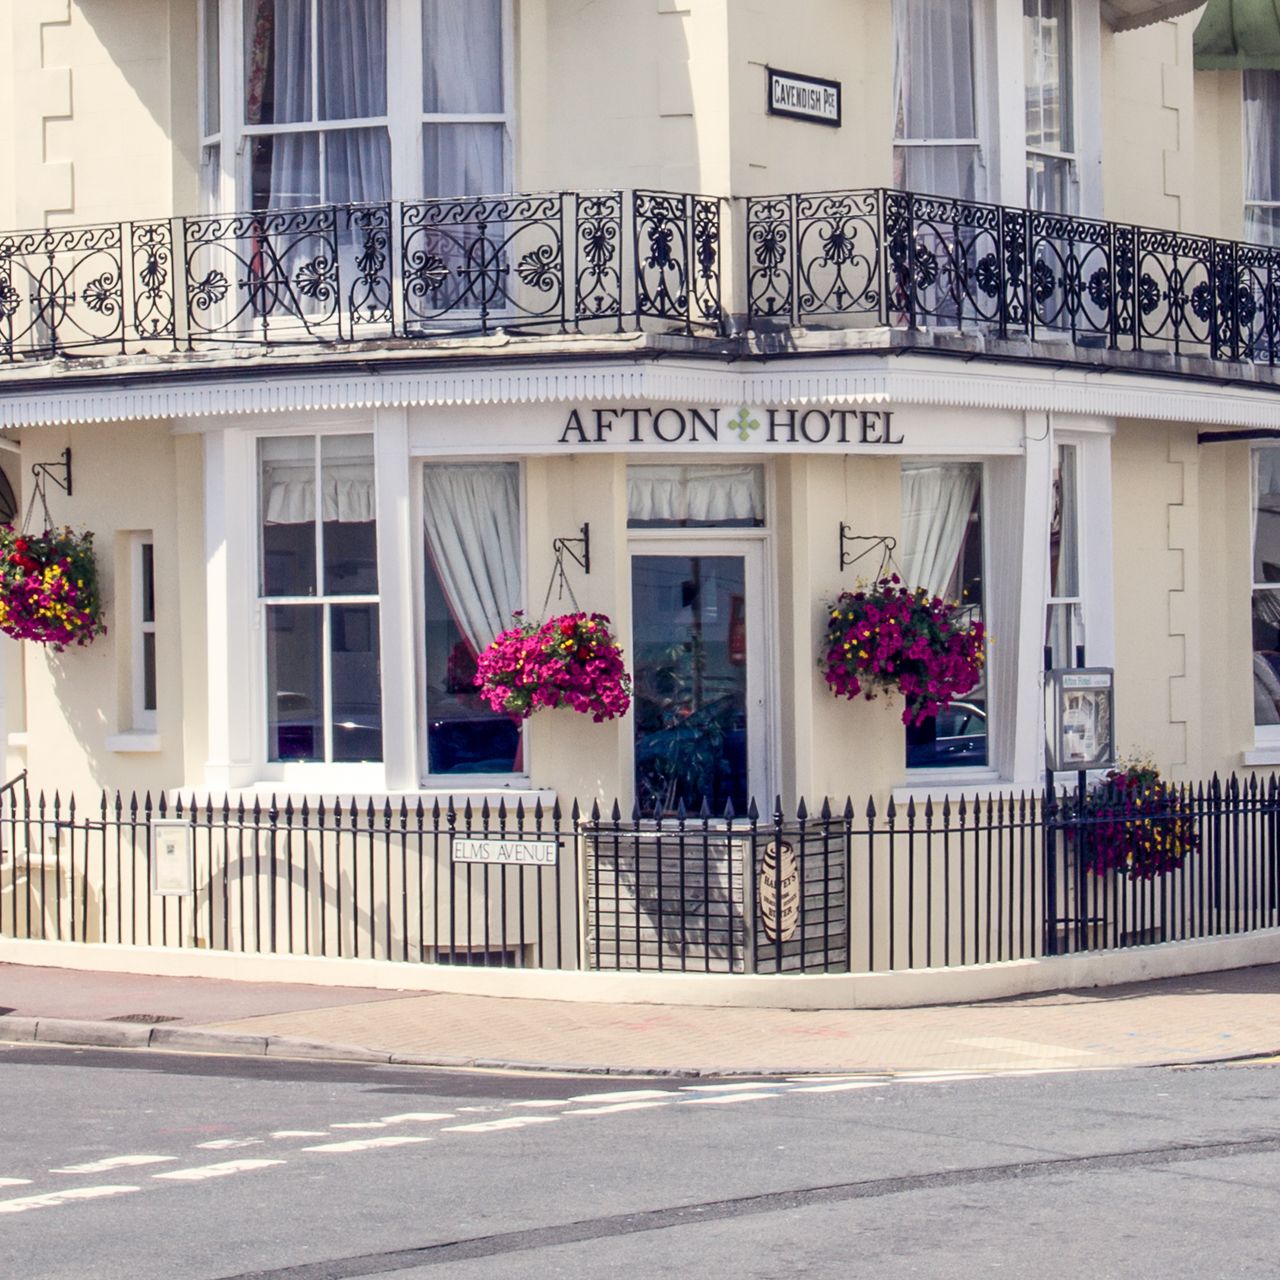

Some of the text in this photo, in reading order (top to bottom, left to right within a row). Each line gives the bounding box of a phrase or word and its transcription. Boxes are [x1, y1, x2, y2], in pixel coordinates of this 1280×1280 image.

[774, 79, 821, 113] CAVENDISH
[557, 408, 905, 444] AFTON HOTEL
[455, 841, 554, 862] ELMS AVENUE
